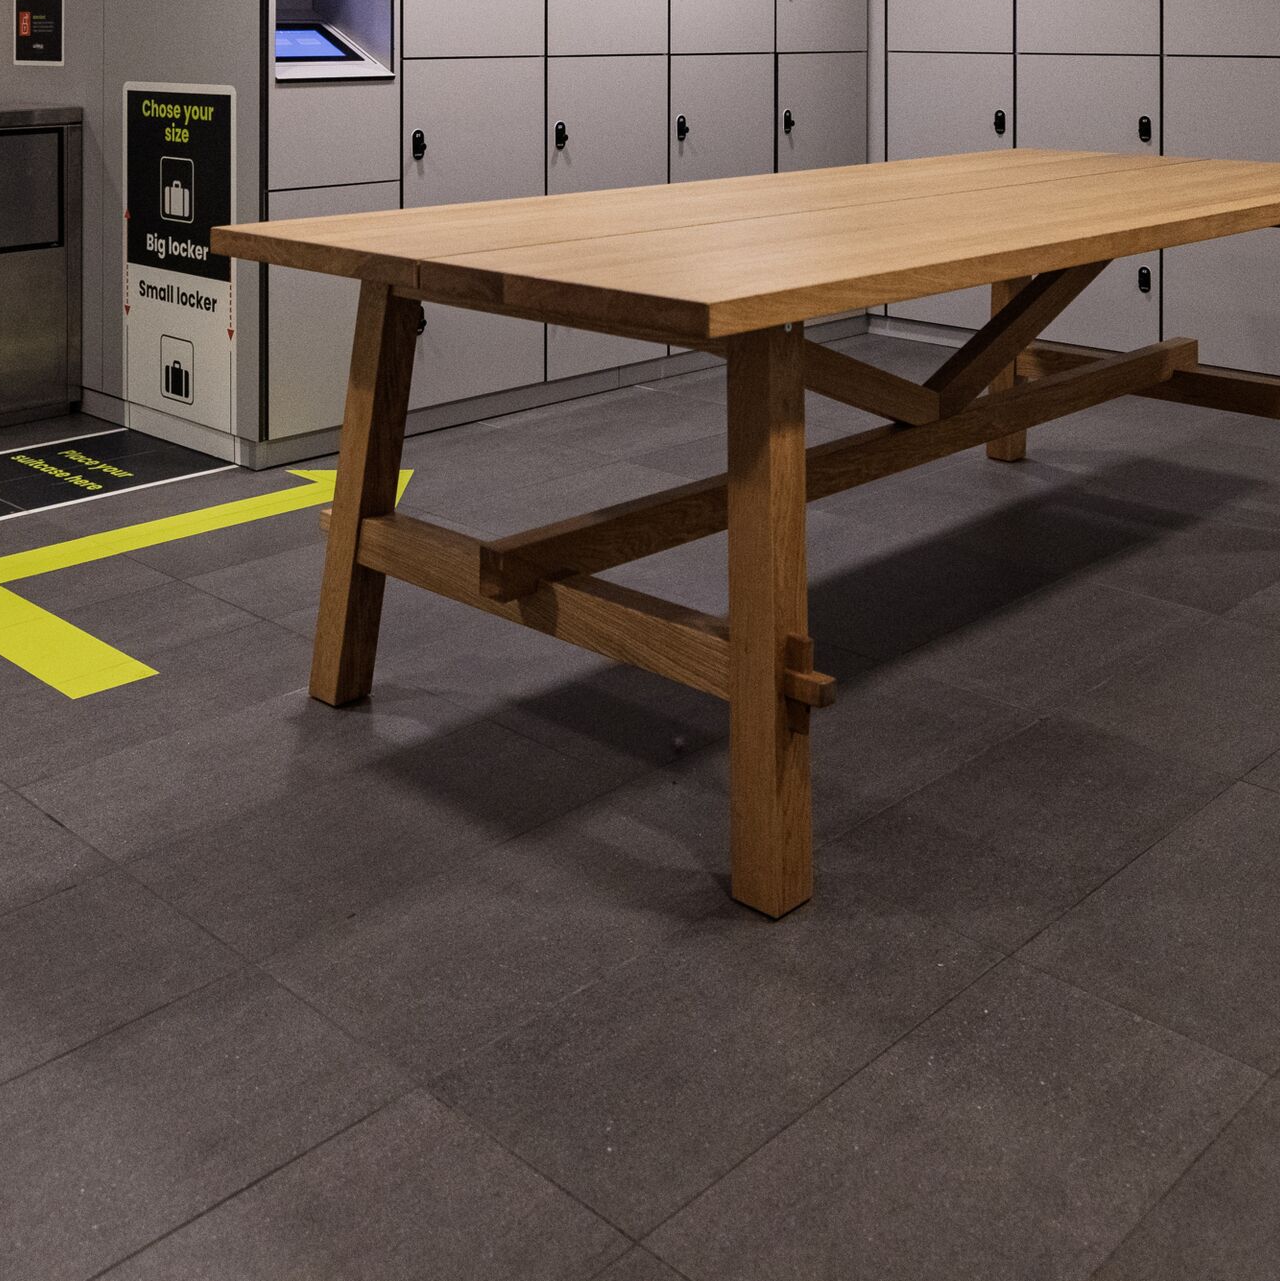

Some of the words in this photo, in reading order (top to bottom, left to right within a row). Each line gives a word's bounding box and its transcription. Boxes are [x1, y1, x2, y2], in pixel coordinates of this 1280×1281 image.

[142, 99, 181, 119] Chose
[183, 105, 214, 125] your
[164, 122, 189, 143] size
[146, 233, 166, 259] Big
[168, 236, 209, 261] locker
[139, 280, 174, 303] Small
[177, 287, 217, 312] locker
[10, 454, 71, 478] suitcase
[63, 474, 103, 491] here
[57, 449, 100, 466] Place
[87, 463, 134, 478] your
